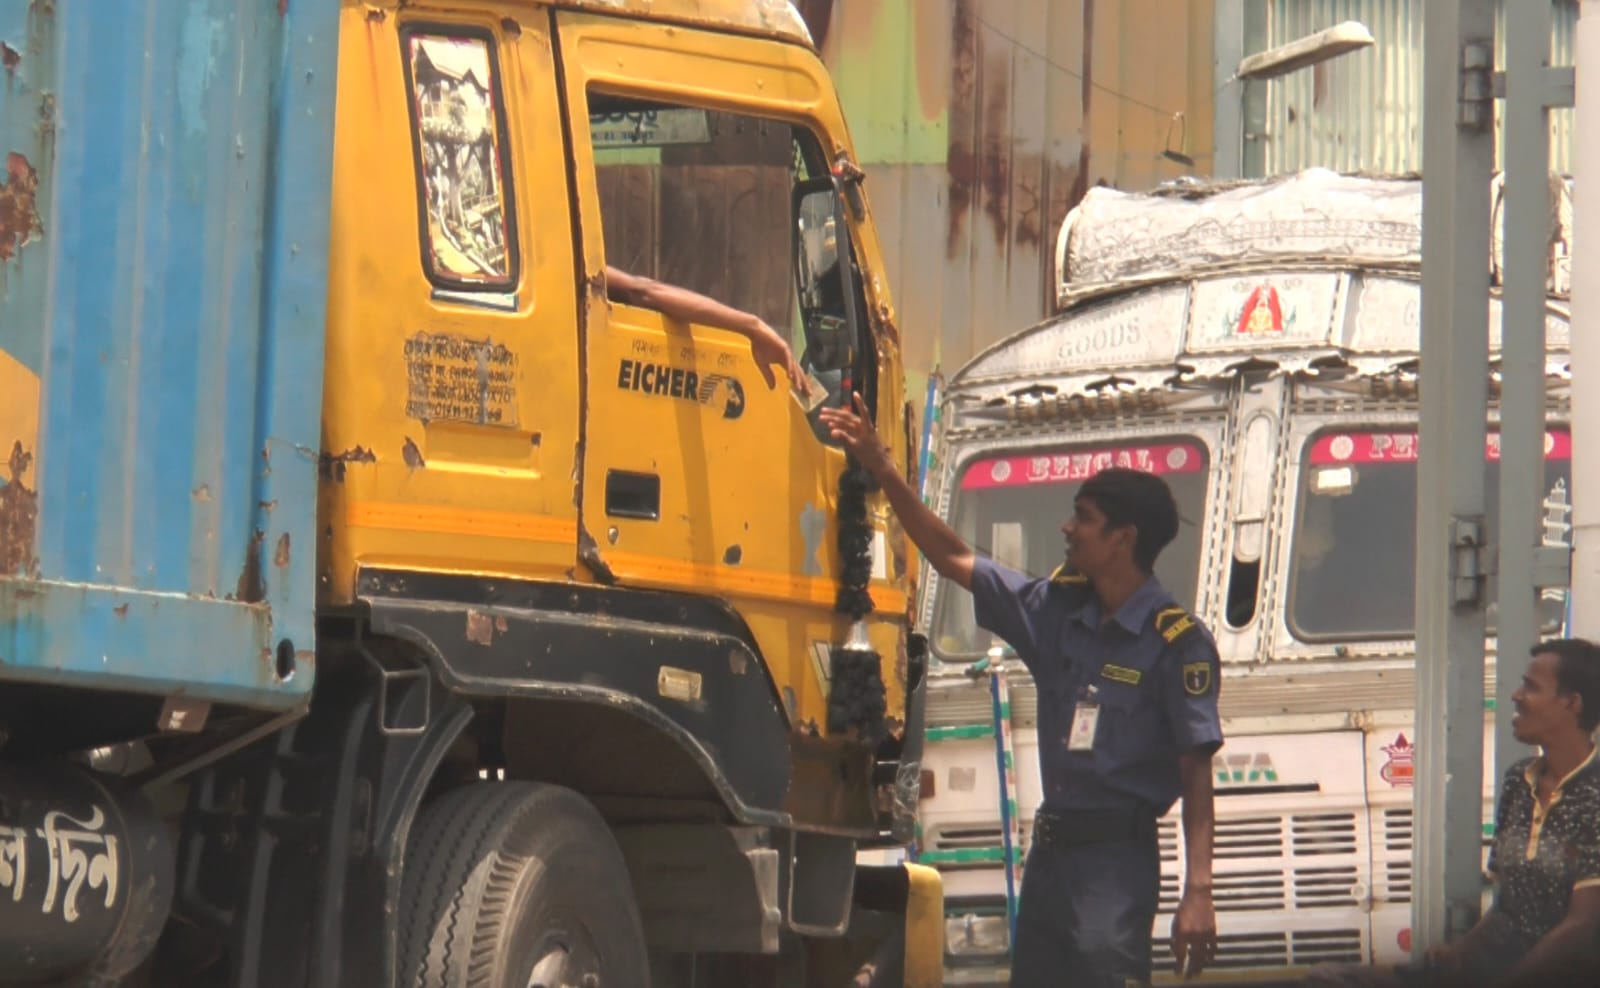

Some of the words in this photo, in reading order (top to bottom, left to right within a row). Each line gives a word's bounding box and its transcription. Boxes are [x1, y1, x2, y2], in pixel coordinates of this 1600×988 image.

[1057, 319, 1141, 358] GOODS
[617, 359, 699, 402] EICHER
[1026, 450, 1154, 482] BENGAL
